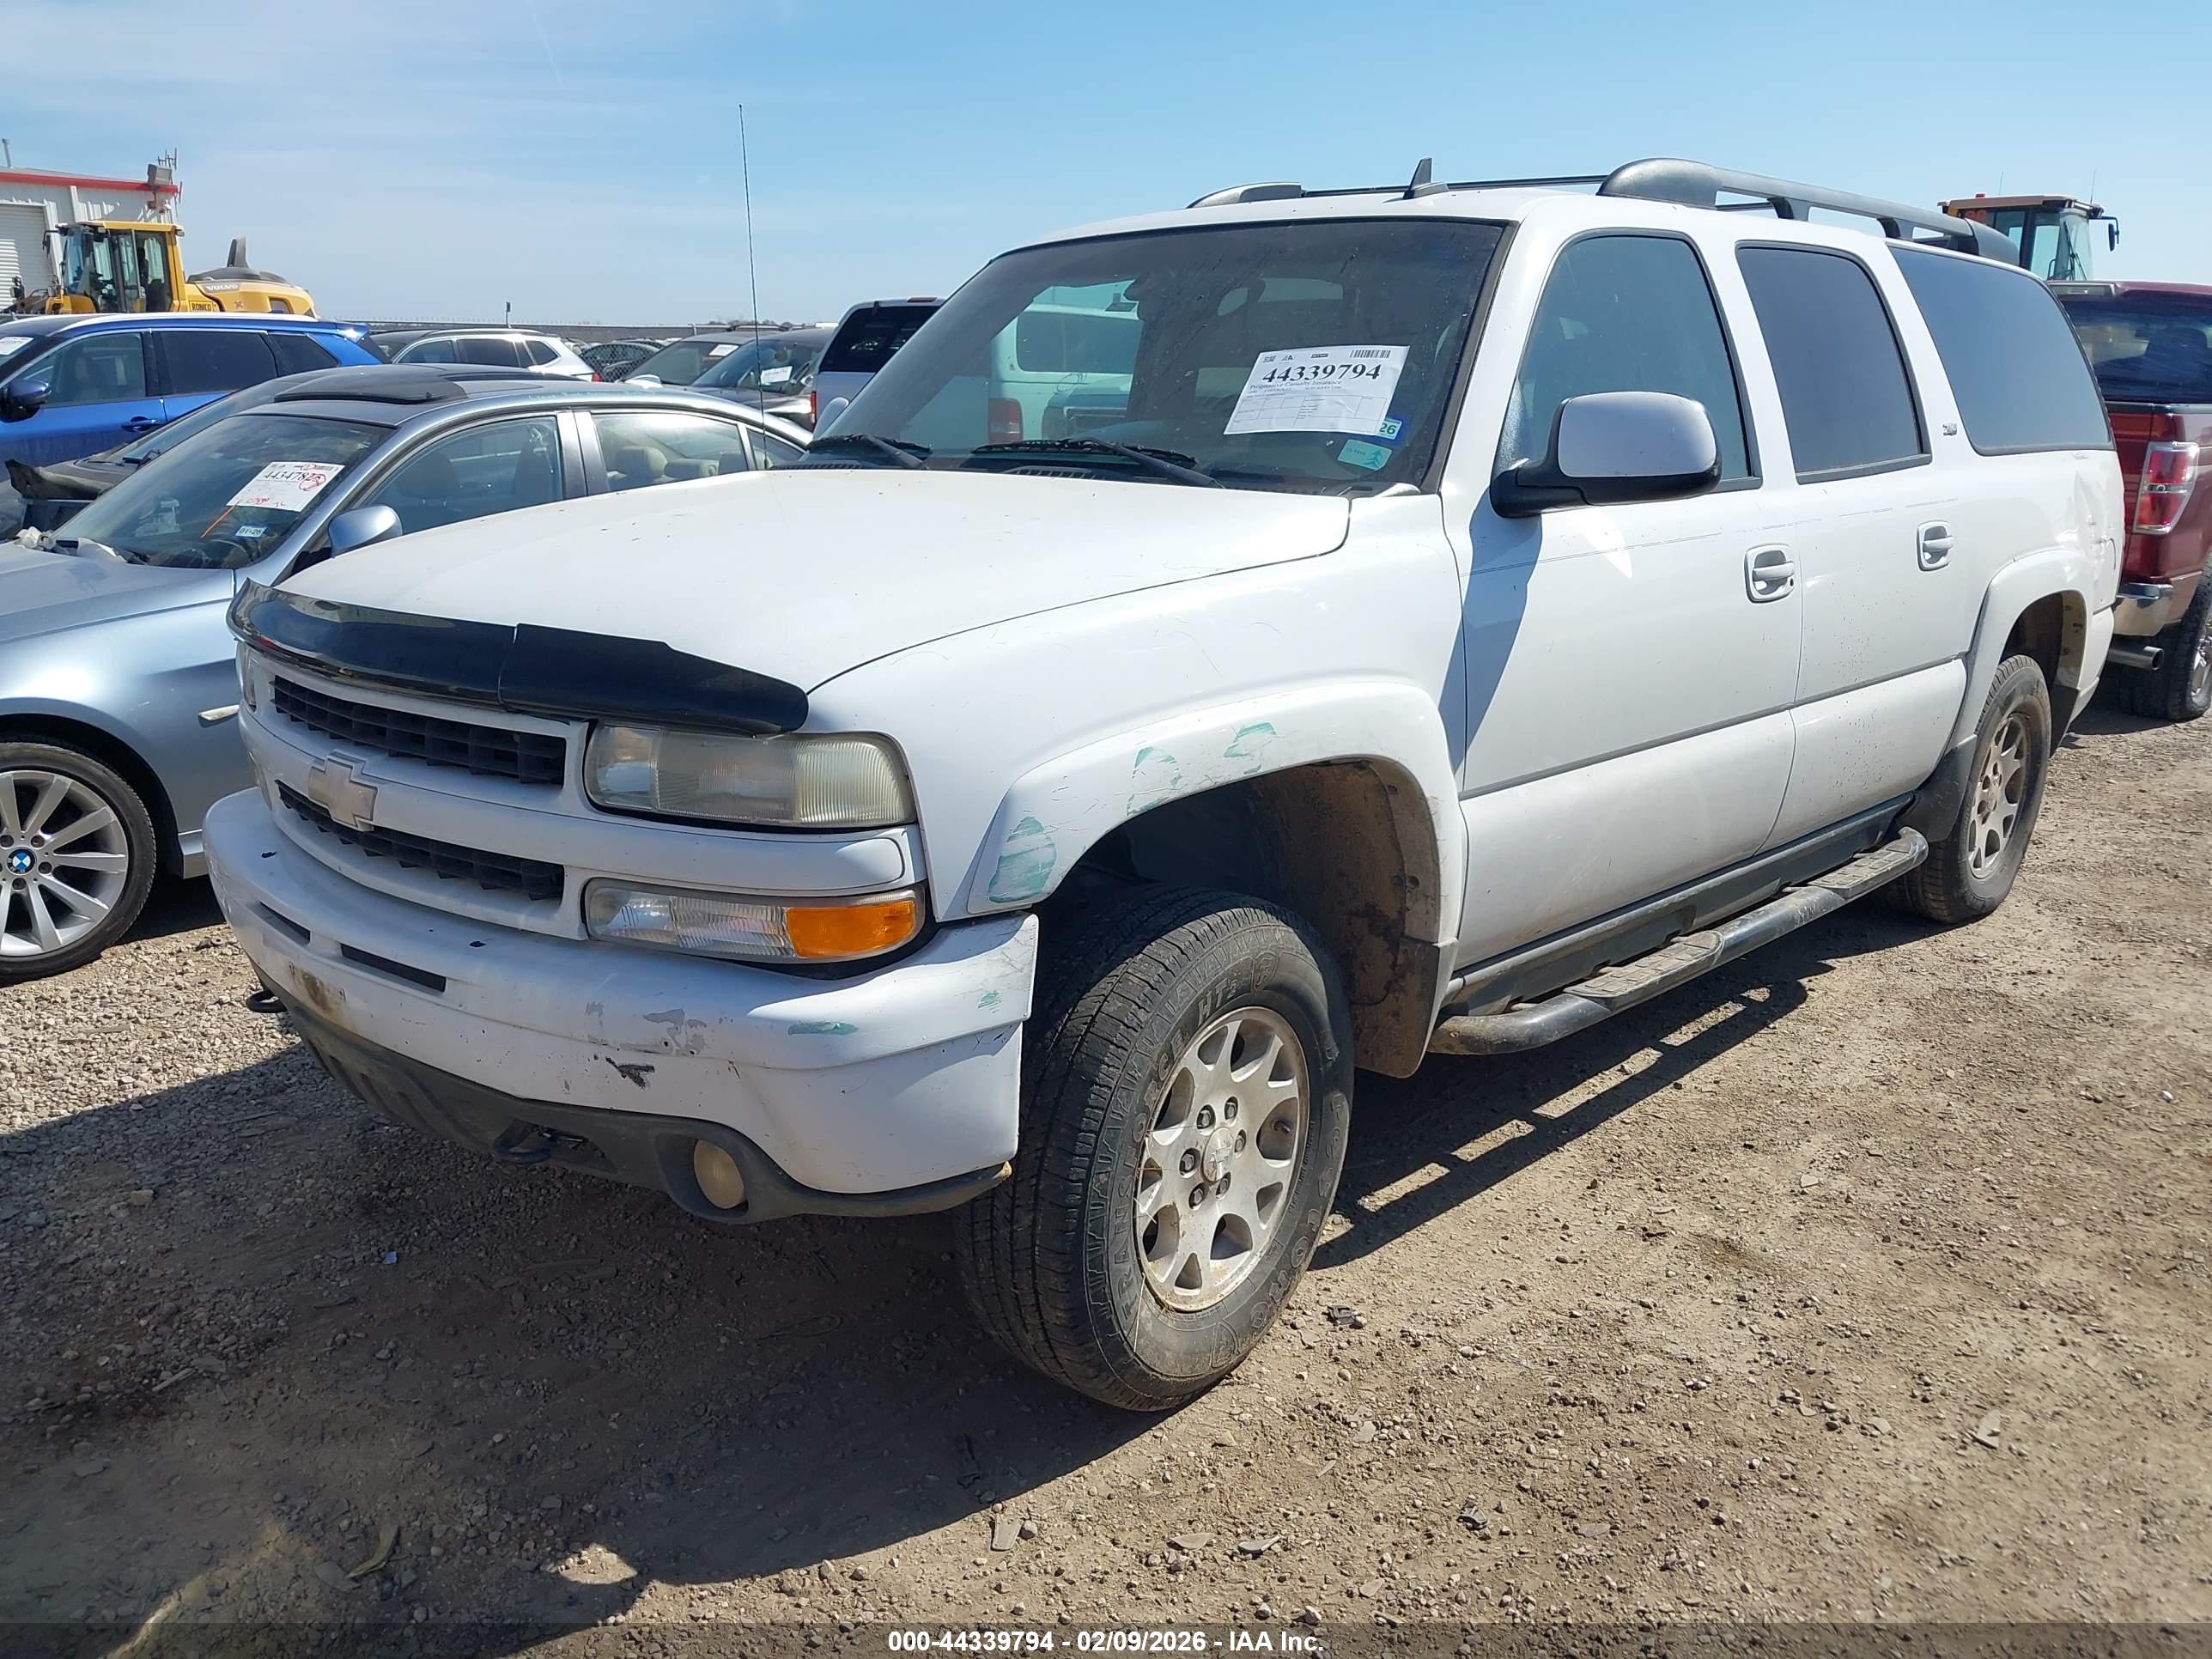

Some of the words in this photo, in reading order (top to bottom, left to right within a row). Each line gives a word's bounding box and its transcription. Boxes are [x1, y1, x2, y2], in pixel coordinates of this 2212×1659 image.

[191, 303, 212, 312] ROMCO
[1262, 363, 1382, 383] 44339794
[1379, 422, 1397, 434] 26
